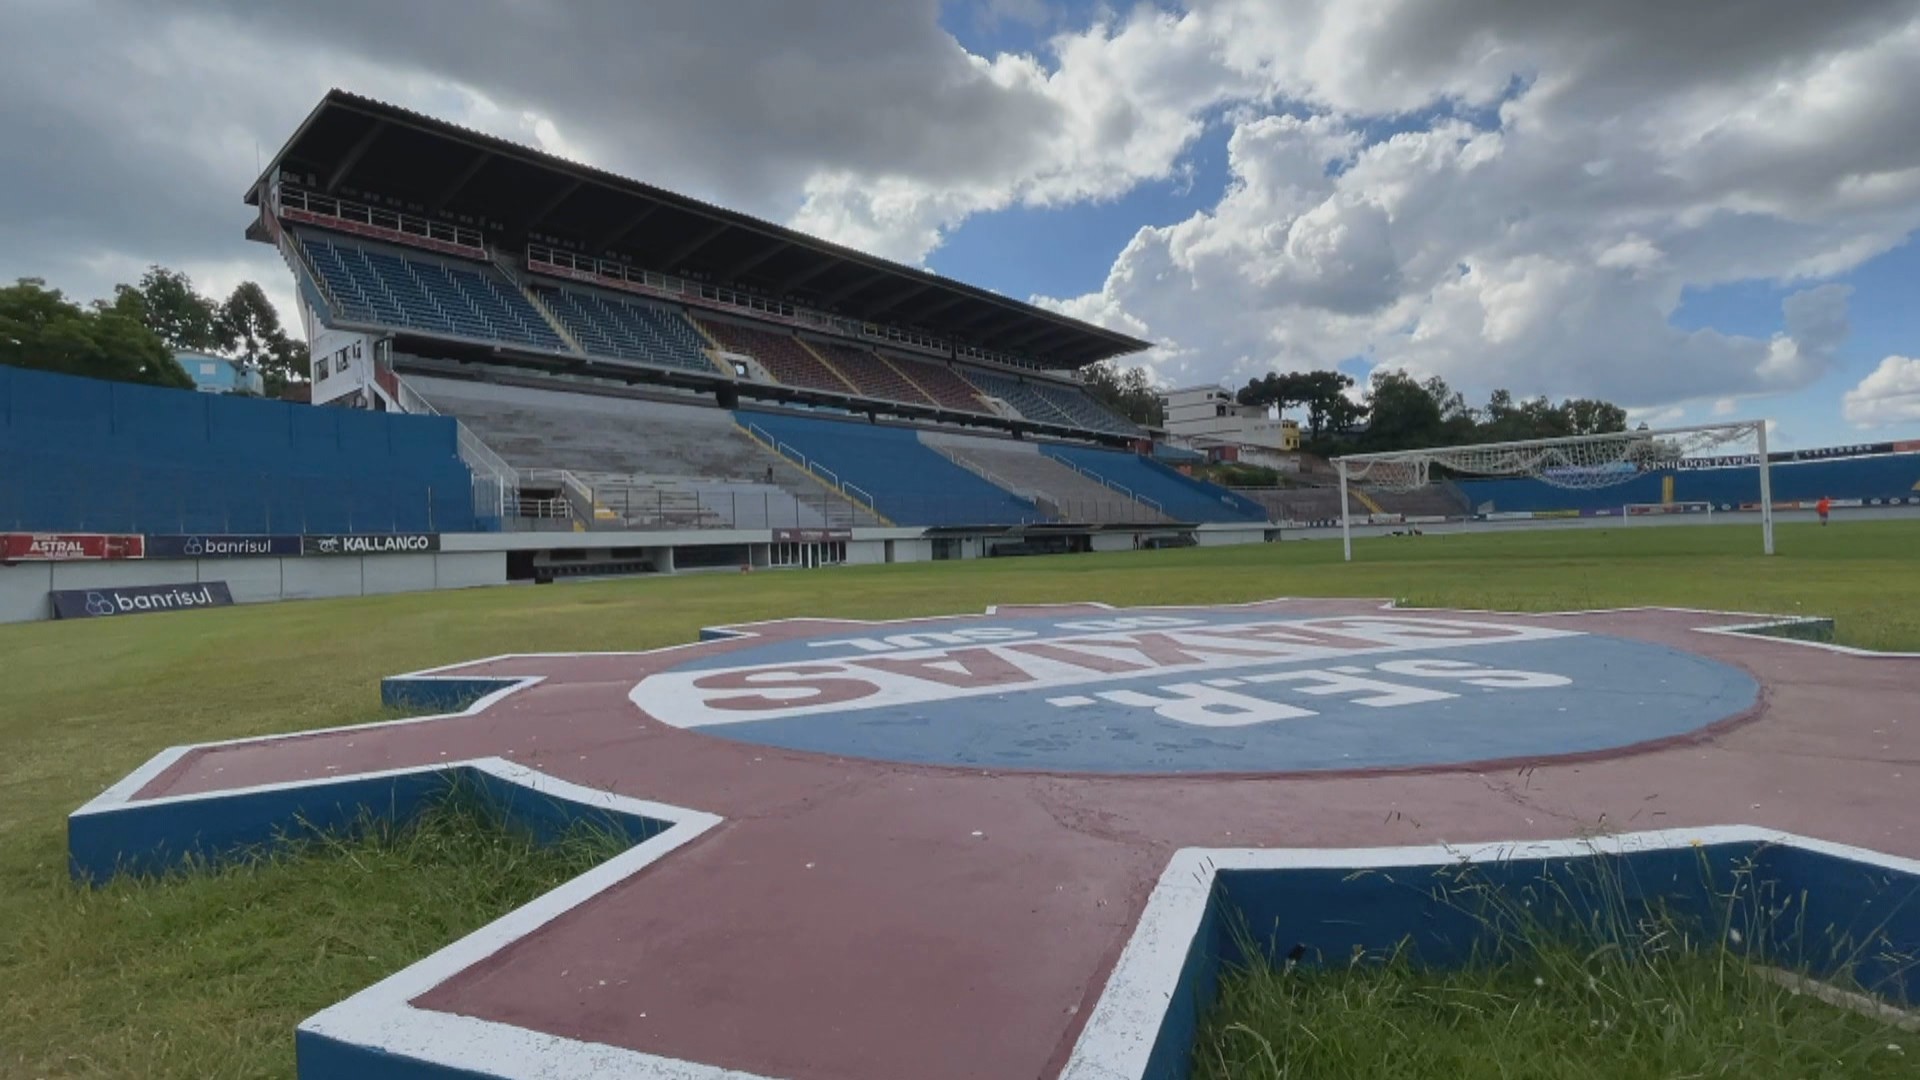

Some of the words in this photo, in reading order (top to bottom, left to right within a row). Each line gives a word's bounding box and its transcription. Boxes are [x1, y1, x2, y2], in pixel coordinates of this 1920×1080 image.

[30, 541, 84, 551] ASTRAL
[205, 538, 271, 554] banrisul
[343, 536, 429, 551] KALLANGO
[114, 586, 213, 611] banrisul
[807, 627, 1039, 652] SUL
[693, 618, 1523, 711] CAXIAS
